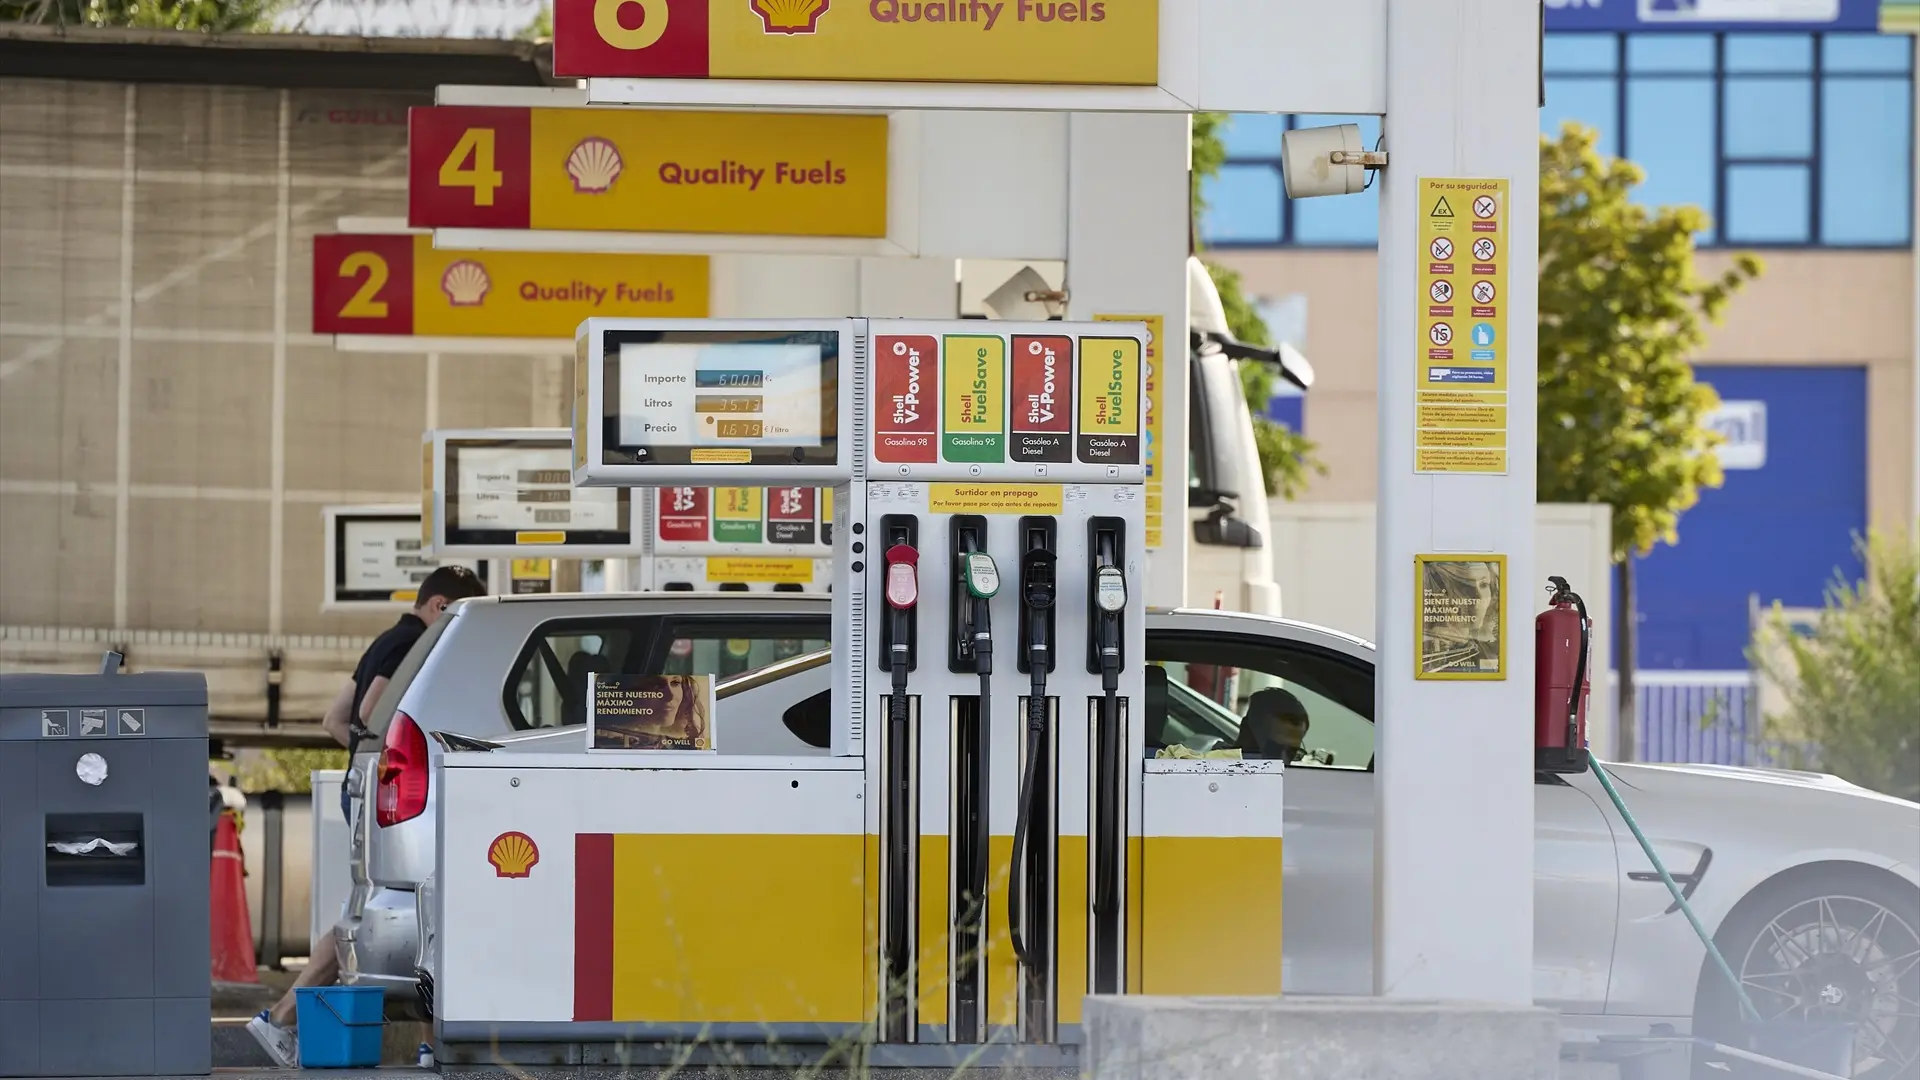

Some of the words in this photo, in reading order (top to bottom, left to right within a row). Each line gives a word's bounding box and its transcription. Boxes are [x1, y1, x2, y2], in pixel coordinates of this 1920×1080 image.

[869, 0, 1003, 31] Quality
[1017, 0, 1106, 22] Fuels
[439, 128, 502, 206] 4
[658, 160, 765, 191] Quality
[776, 160, 847, 184] Fuels
[1430, 181, 1444, 189] Por
[1457, 182, 1498, 191] seguridad
[338, 251, 389, 318] 2
[519, 281, 607, 306] Quality
[616, 281, 675, 303] Fuels
[644, 374, 686, 384] Importe
[905, 348, 920, 424] V-Power
[972, 348, 987, 423] FuelSave
[1040, 347, 1055, 423] V-Power
[1108, 349, 1122, 424] FuelSave
[644, 398, 673, 408] Litros
[893, 395, 904, 424] Shell
[961, 395, 971, 423] Shell
[1028, 395, 1039, 423] Shell
[1096, 397, 1106, 424] Shell
[644, 423, 677, 433] Precio
[884, 438, 916, 446] Gasolina
[917, 438, 928, 446] 98
[952, 437, 984, 446] Gasolina
[985, 437, 995, 446] 95
[1022, 437, 1051, 446] Gasóleo
[1022, 447, 1043, 455] Diesel
[1089, 438, 1119, 447] Gasóleo
[1120, 439, 1127, 447] A
[1089, 448, 1110, 456] Diesel
[954, 488, 988, 497] Surtidor
[1003, 490, 1038, 498] prepago
[1424, 606, 1459, 614] MÁXIMO
